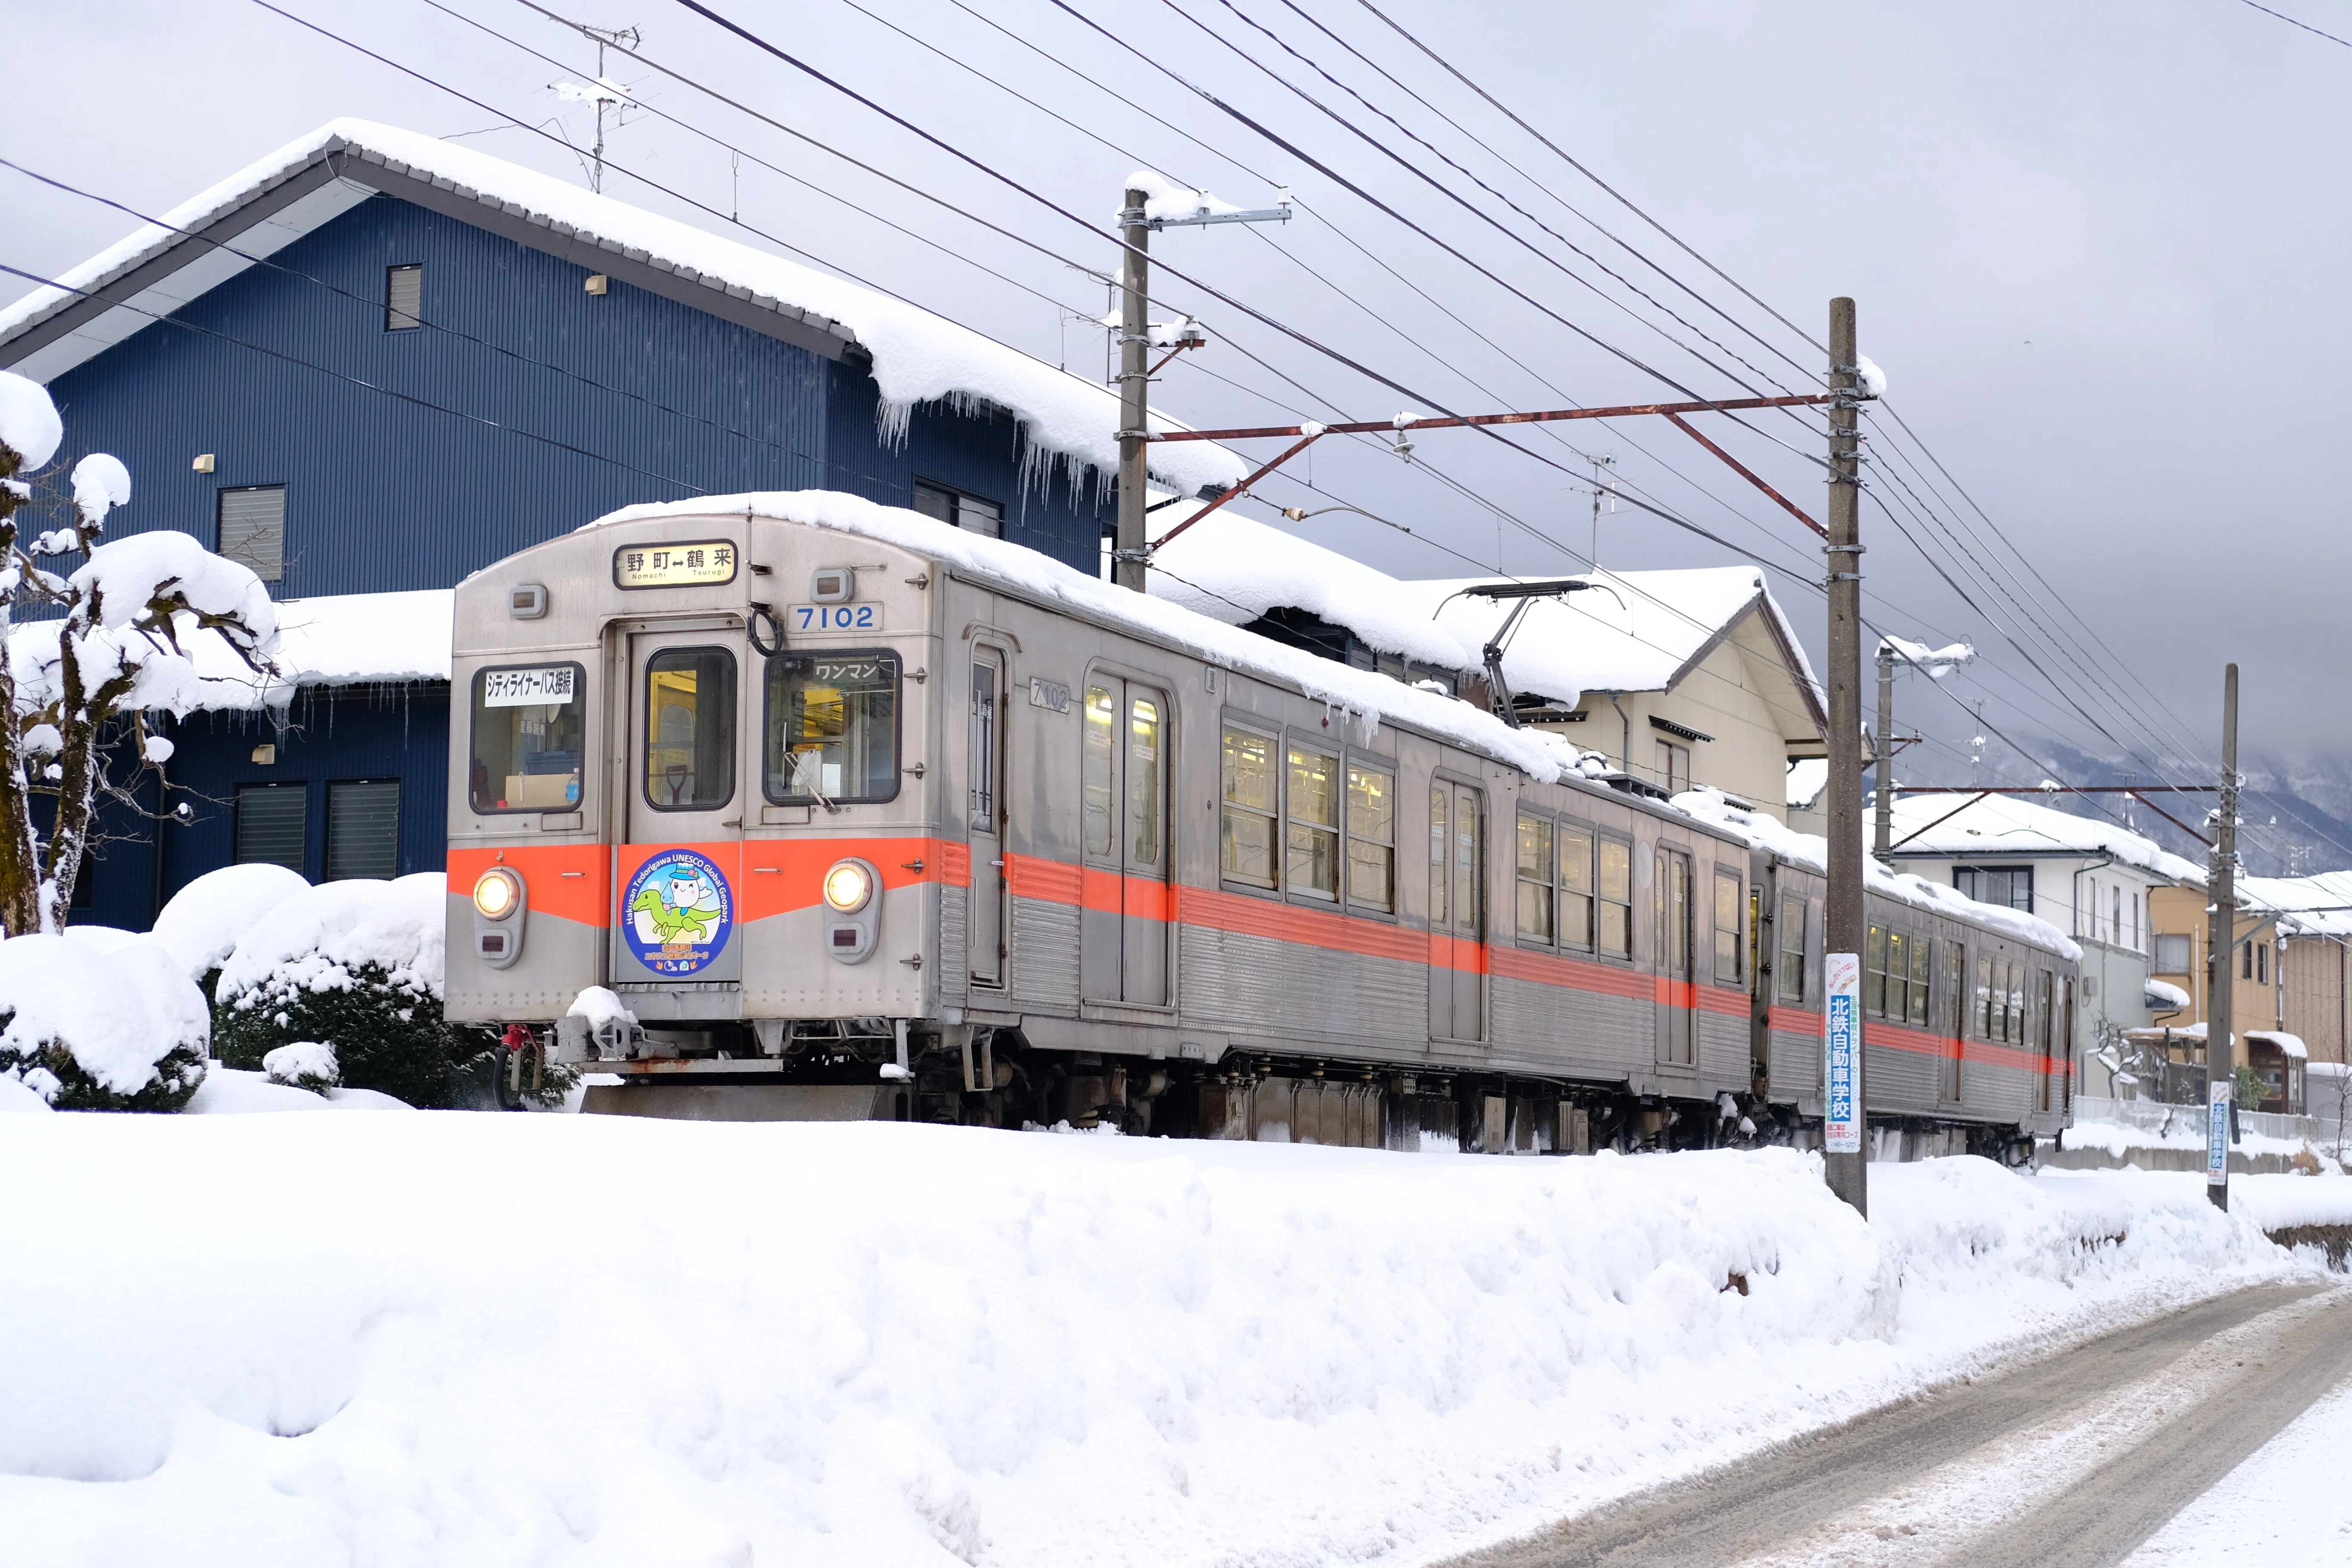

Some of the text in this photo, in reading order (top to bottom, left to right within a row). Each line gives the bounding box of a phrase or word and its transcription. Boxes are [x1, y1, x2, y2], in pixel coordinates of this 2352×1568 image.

[627, 547, 732, 572] 野町 鶴来
[797, 606, 873, 629] 7102
[488, 669, 572, 697] シティライナーバス接続
[816, 664, 877, 680] ワンマン
[1034, 682, 1067, 709] 7102
[626, 854, 729, 925] Hakusan Tedorigawa UNESCO Global Geopark
[644, 951, 709, 960] ユネスコ世界ジオパーク
[1831, 998, 1849, 1118] 北鉄自動車学校
